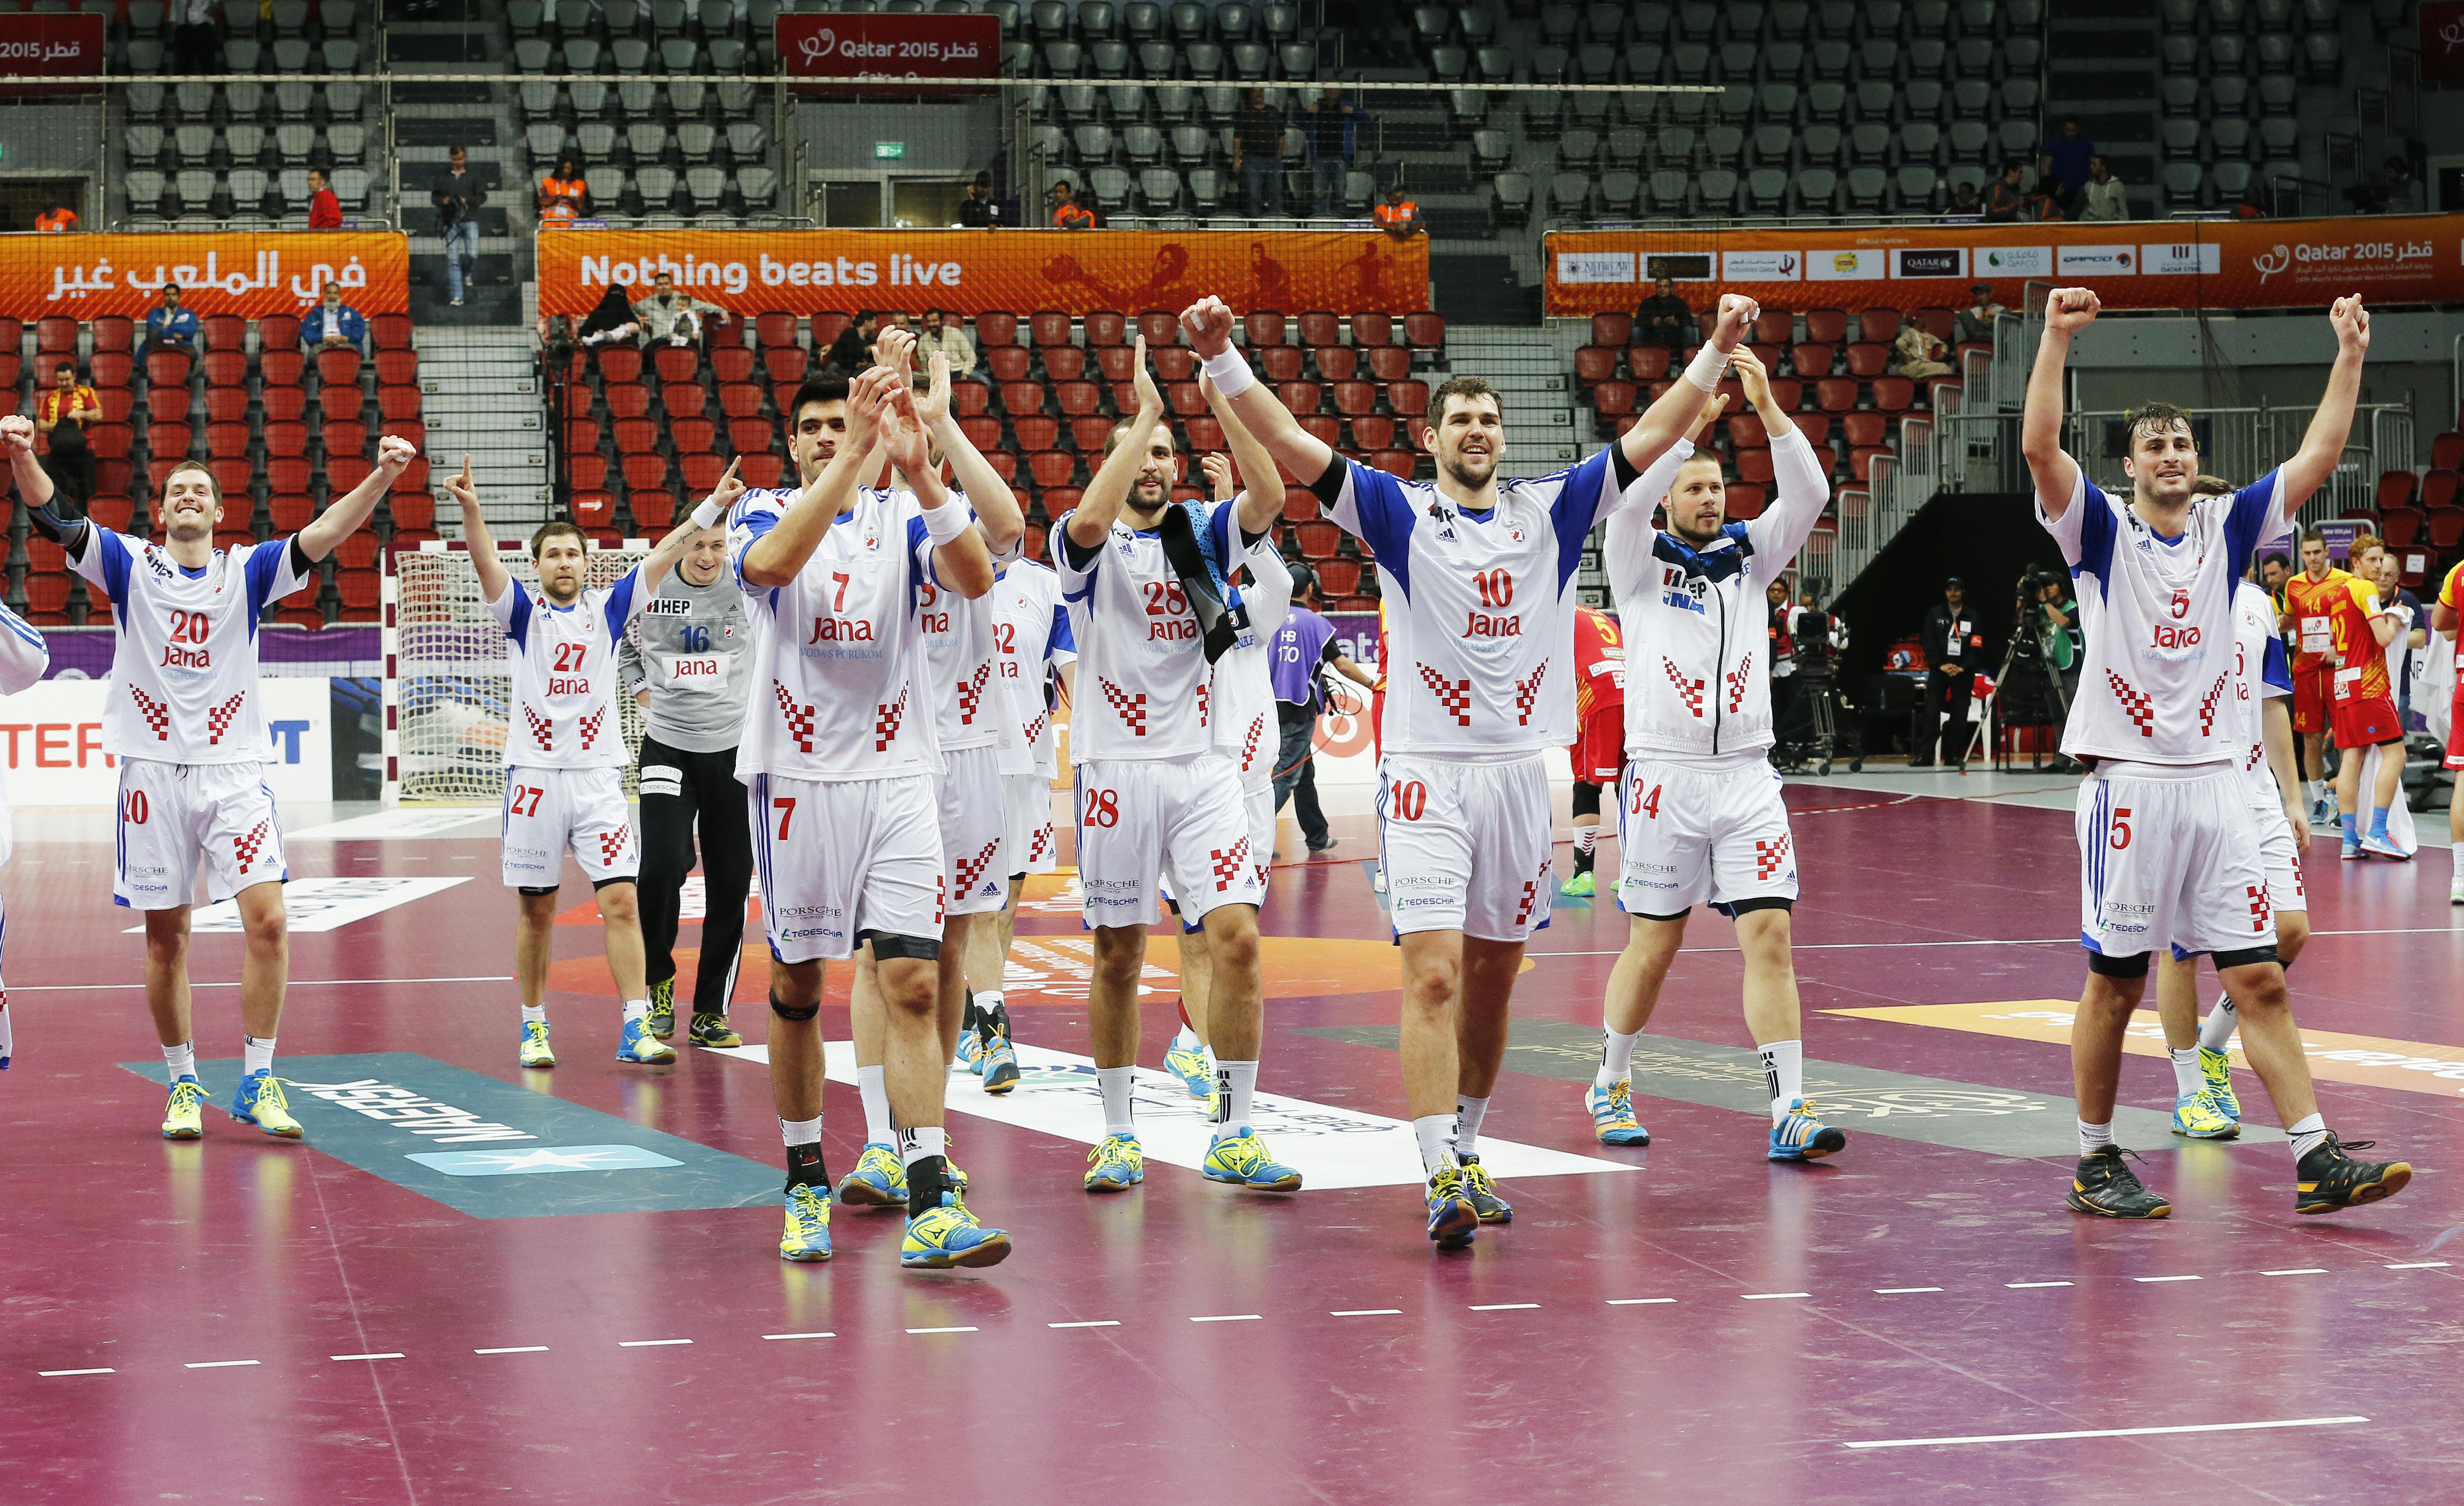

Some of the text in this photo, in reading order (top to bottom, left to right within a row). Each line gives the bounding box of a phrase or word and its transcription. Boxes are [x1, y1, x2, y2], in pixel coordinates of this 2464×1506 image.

[0, 42, 40, 57] 2015
[42, 41, 80, 62] قطر
[840, 40, 939, 58] Qatar 2015
[941, 42, 978, 61] قطر
[2295, 243, 2394, 262] Qatar 2015
[2396, 240, 2433, 262] قطر
[1907, 258, 1939, 268] QATAR
[47, 251, 366, 307] في الملعب غير
[581, 254, 961, 294] Nothing beats live
[832, 571, 849, 612] 7
[1472, 568, 1513, 607] 10
[661, 600, 690, 614] HEP
[1144, 581, 1187, 616] 28
[2171, 589, 2190, 619] 5
[2306, 597, 2321, 614] 14
[170, 610, 210, 644] 20
[808, 617, 874, 645] Jana
[1147, 618, 1197, 641] Jana
[1462, 612, 1523, 638] Jana
[1589, 614, 1618, 645] 5
[679, 625, 709, 654] 16
[1280, 630, 1297, 643] HB
[2151, 625, 2201, 649] Jana
[160, 646, 211, 667] Jana
[554, 642, 587, 672] 27
[800, 648, 883, 659] VODA S PORUKOM
[1139, 642, 1164, 653] VODA
[1277, 646, 1300, 664] 170
[673, 660, 718, 679] Jana
[545, 678, 591, 697] Jana
[511, 784, 544, 817] 27
[1084, 788, 1119, 828] 28
[1391, 780, 1426, 821] 10
[1630, 778, 1662, 819] 34
[774, 798, 796, 840] 7
[2111, 808, 2132, 849] 5
[506, 846, 549, 857] PORSCHE
[1626, 859, 1678, 872] PORSCHE
[1084, 879, 1139, 889] PORSCHE
[1395, 876, 1455, 886] PORSCHE
[1633, 879, 1678, 889] TEDESCHIA
[780, 906, 842, 917] PORSCHE
[1093, 897, 1138, 906] TEDESCHIA
[792, 928, 843, 938] TEDESCHIA
[286, 1079, 539, 1144] MAERSK
[1280, 1114, 1400, 1132] Qatar
